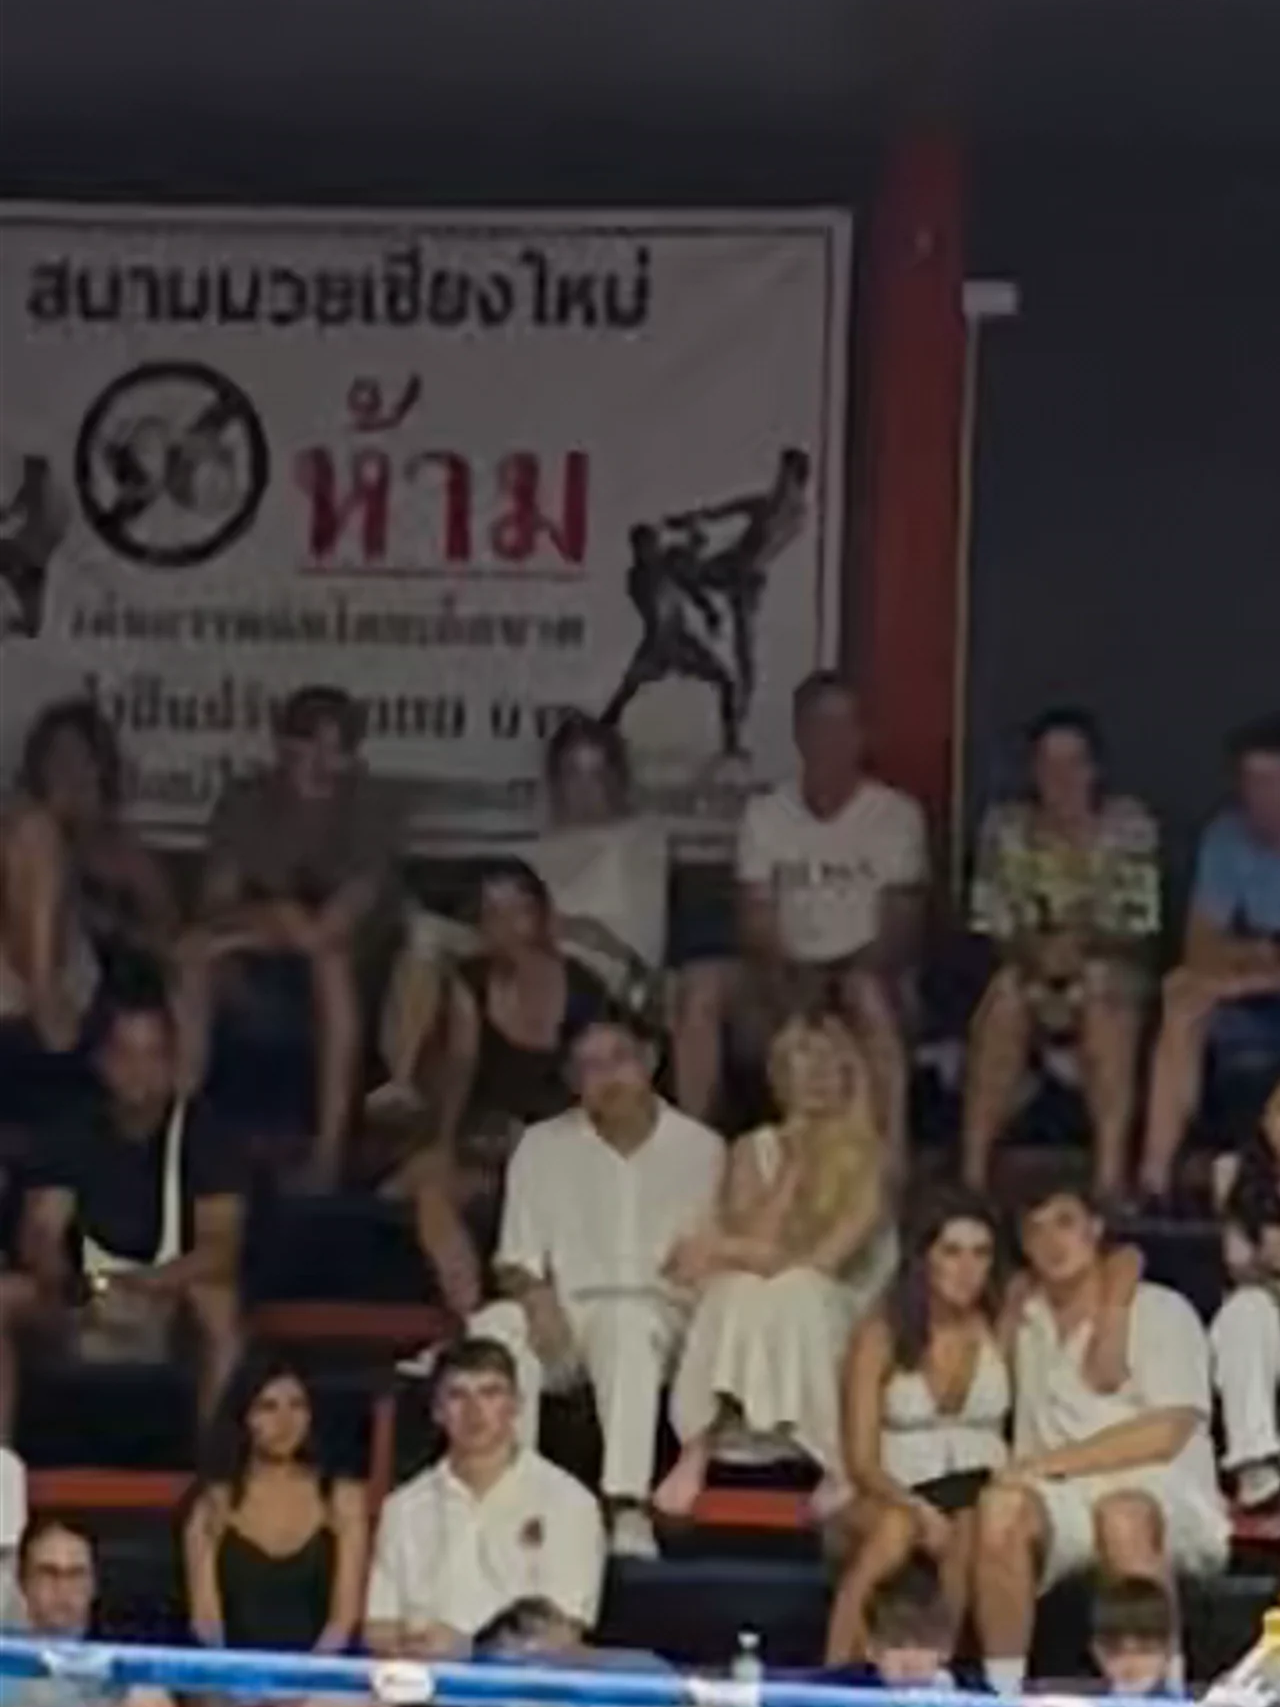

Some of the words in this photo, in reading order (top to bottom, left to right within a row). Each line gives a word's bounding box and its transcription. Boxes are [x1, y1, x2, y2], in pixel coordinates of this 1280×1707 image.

[27, 246, 652, 329] สนามมวยเชียงใหม่
[293, 374, 590, 565] ห้าม
